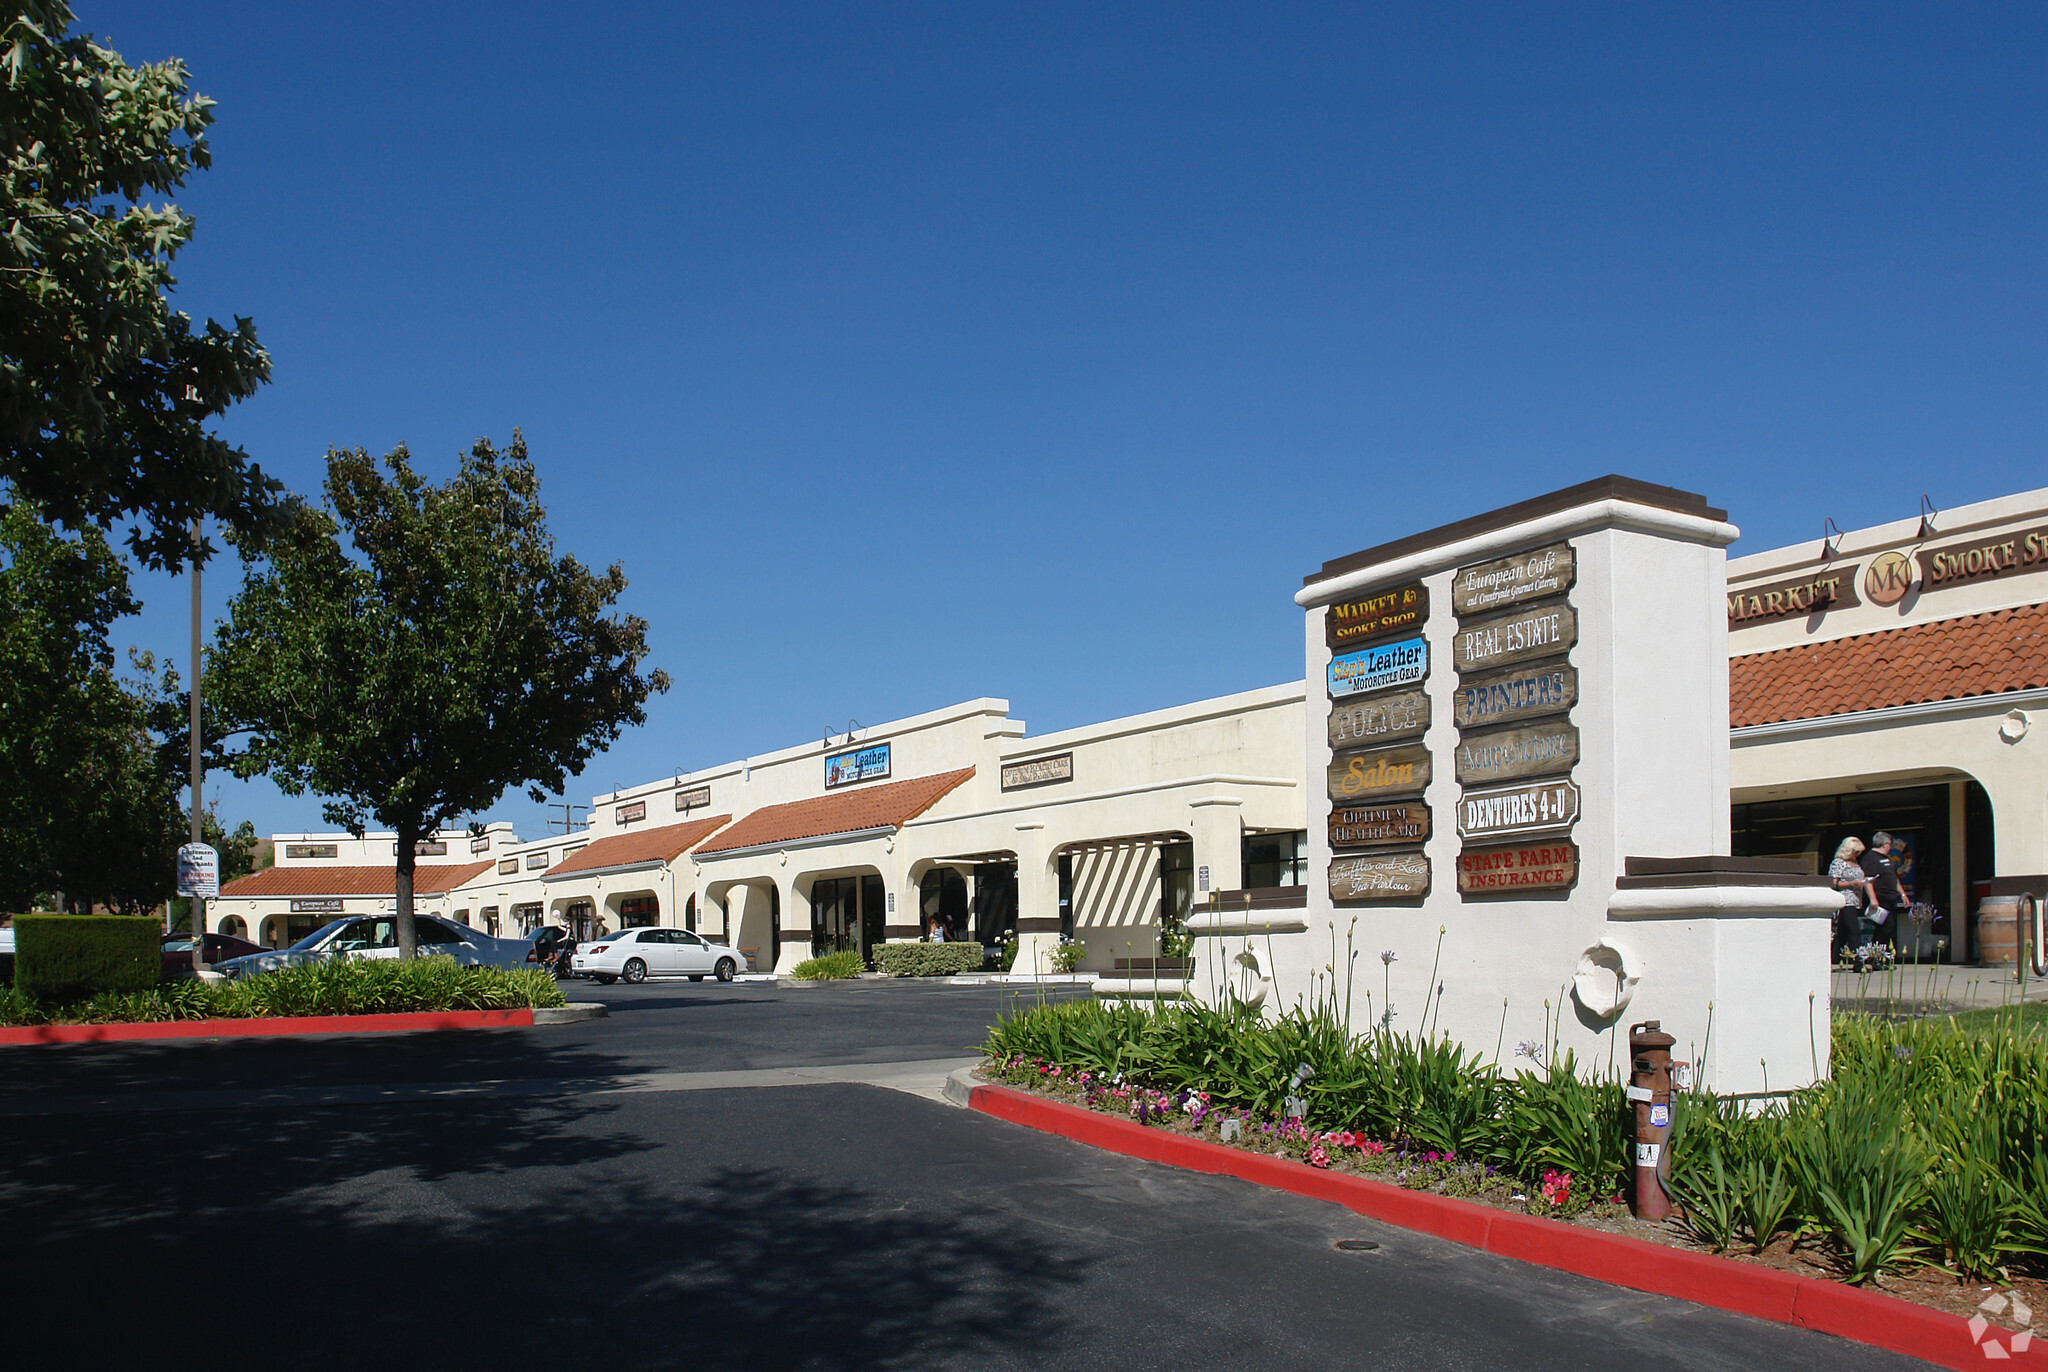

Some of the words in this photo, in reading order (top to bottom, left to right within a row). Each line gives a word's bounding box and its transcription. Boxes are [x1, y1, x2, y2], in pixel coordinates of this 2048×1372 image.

[1465, 564, 1524, 592] European
[1527, 551, 1556, 580] Café
[1931, 540, 2018, 581] SMOKE
[1466, 593, 1478, 607] and
[1478, 586, 1511, 604] Countryside
[1511, 581, 1534, 601] Gourmet
[1534, 575, 1559, 592] Catering
[1334, 593, 1397, 625] MARKET
[1403, 590, 1417, 607] &
[1336, 621, 1378, 641] SMOKE
[1381, 611, 1416, 630] SHOP
[1465, 628, 1503, 662] REAL
[1506, 614, 1560, 652] ESTATE
[1368, 646, 1422, 673] Leather
[1352, 669, 1398, 692] MOTORCYCLE
[1400, 666, 1420, 681] GEAR
[1465, 673, 1564, 717] PRINTERS
[1337, 697, 1417, 740] POLICE
[855, 750, 887, 768] Leather
[1462, 733, 1568, 773] Acupuncture
[1341, 757, 1414, 794] Salon
[1342, 807, 1408, 825] OPTIMUM
[1467, 792, 1537, 830] DENTURES
[1375, 857, 1397, 871] and
[1399, 857, 1426, 874] Lace
[1463, 852, 1514, 872] STATE
[1518, 847, 1569, 867] FARM
[1349, 876, 1370, 896] Tea
[1370, 874, 1411, 891] Parlour
[1469, 869, 1564, 888] INSURANCE
